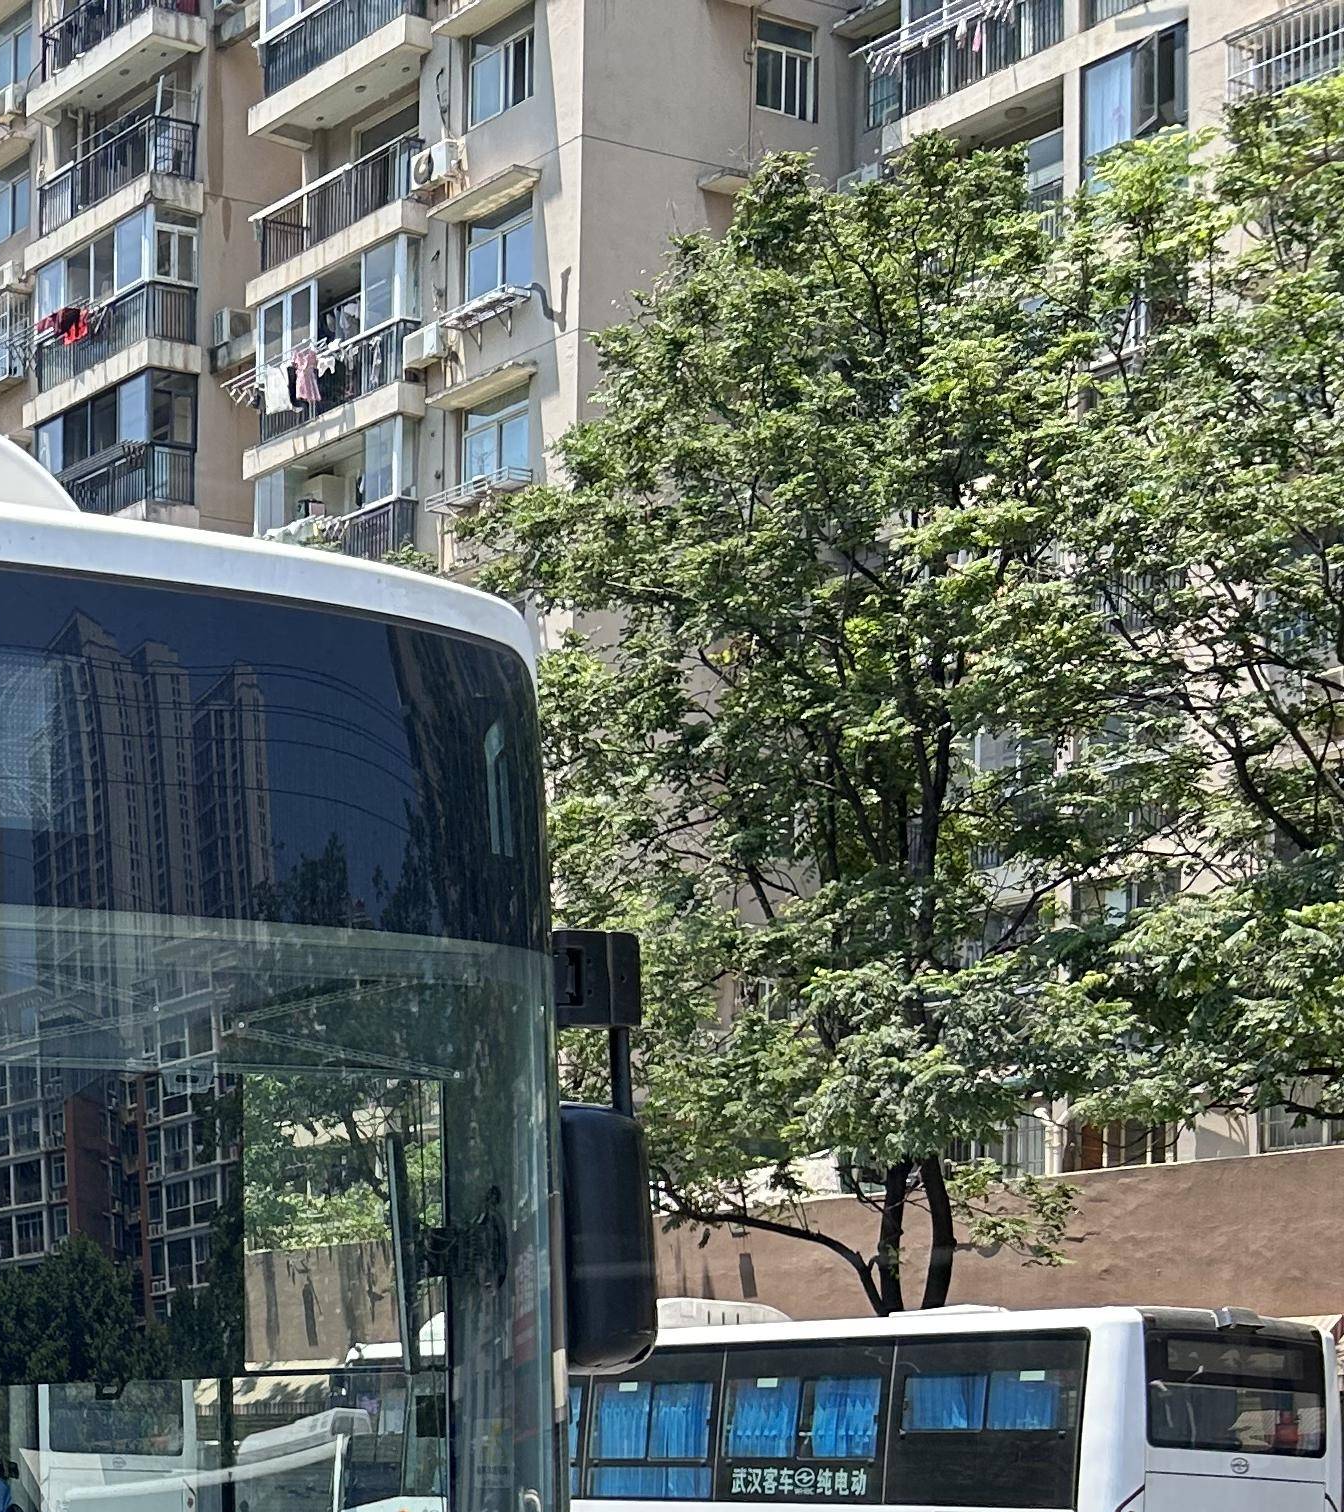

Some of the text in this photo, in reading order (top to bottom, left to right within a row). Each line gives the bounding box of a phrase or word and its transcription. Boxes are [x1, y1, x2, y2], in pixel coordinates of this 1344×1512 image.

[731, 1467, 867, 1496] 武汉客车 纯电动
